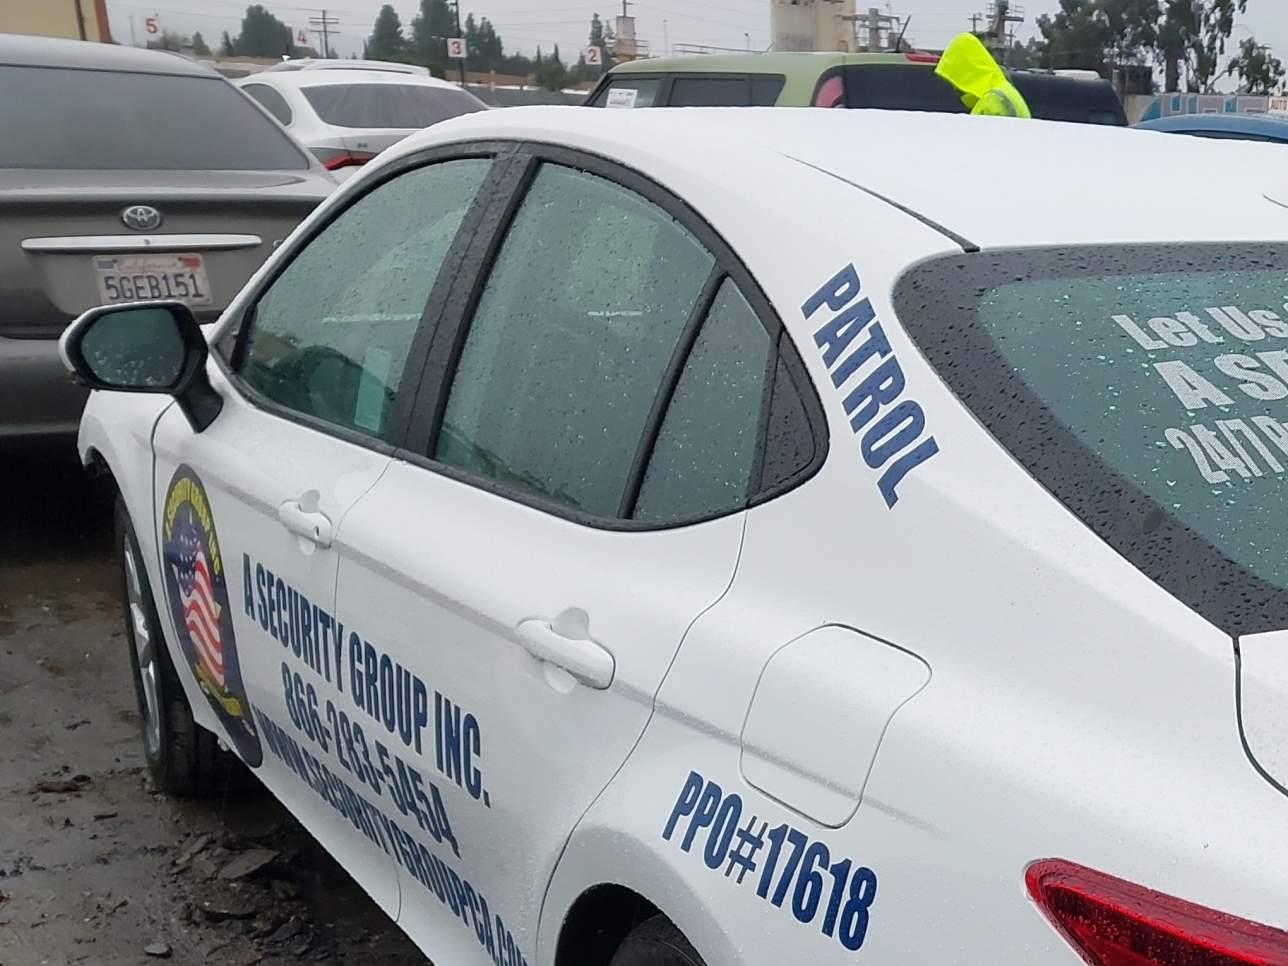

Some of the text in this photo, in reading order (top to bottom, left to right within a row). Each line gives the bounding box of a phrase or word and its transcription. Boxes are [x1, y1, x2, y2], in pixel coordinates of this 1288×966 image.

[145, 18, 158, 34] 5
[450, 40, 462, 55] 3
[588, 49, 598, 63] 2
[103, 273, 204, 300] 5GEB151
[1111, 311, 1225, 350] Let
[800, 262, 940, 511] PATROL
[1152, 359, 1235, 410] A
[241, 551, 491, 809] A SECURITY GROUP INC.
[281, 661, 462, 860] 866-283-5454
[661, 769, 879, 952] PPO#17618
